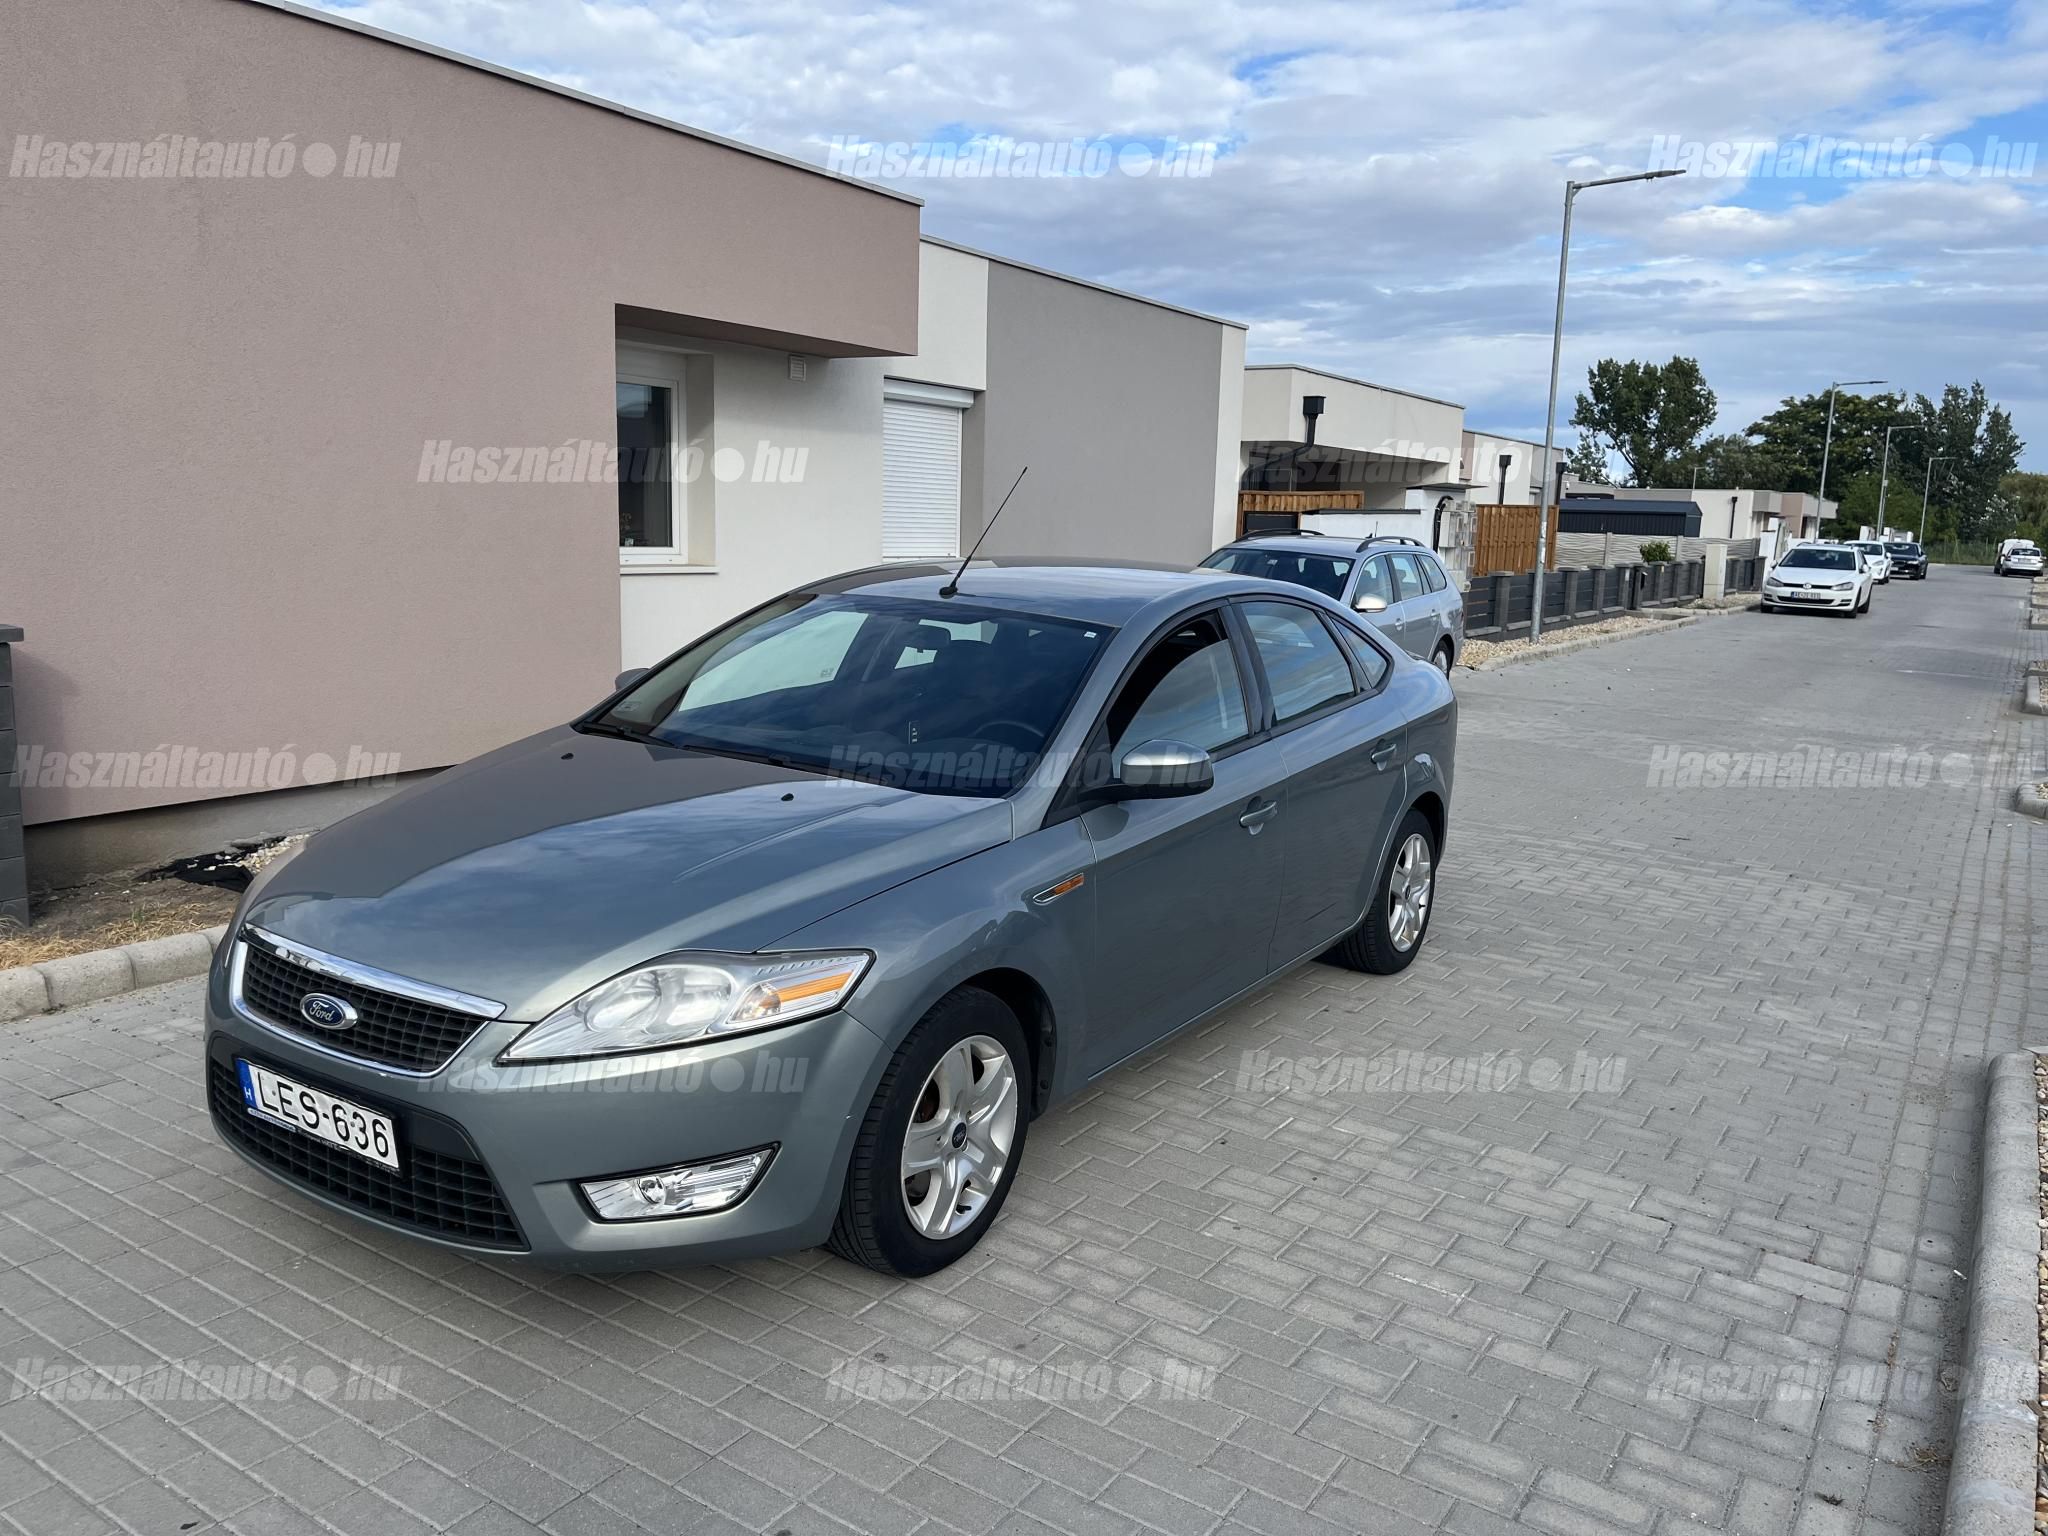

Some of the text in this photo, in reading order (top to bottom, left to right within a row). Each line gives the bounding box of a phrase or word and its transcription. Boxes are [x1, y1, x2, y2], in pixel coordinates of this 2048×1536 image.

[310, 1001, 335, 1021] Ford
[243, 1086, 253, 1101] H
[257, 1071, 389, 1158] LES-636
